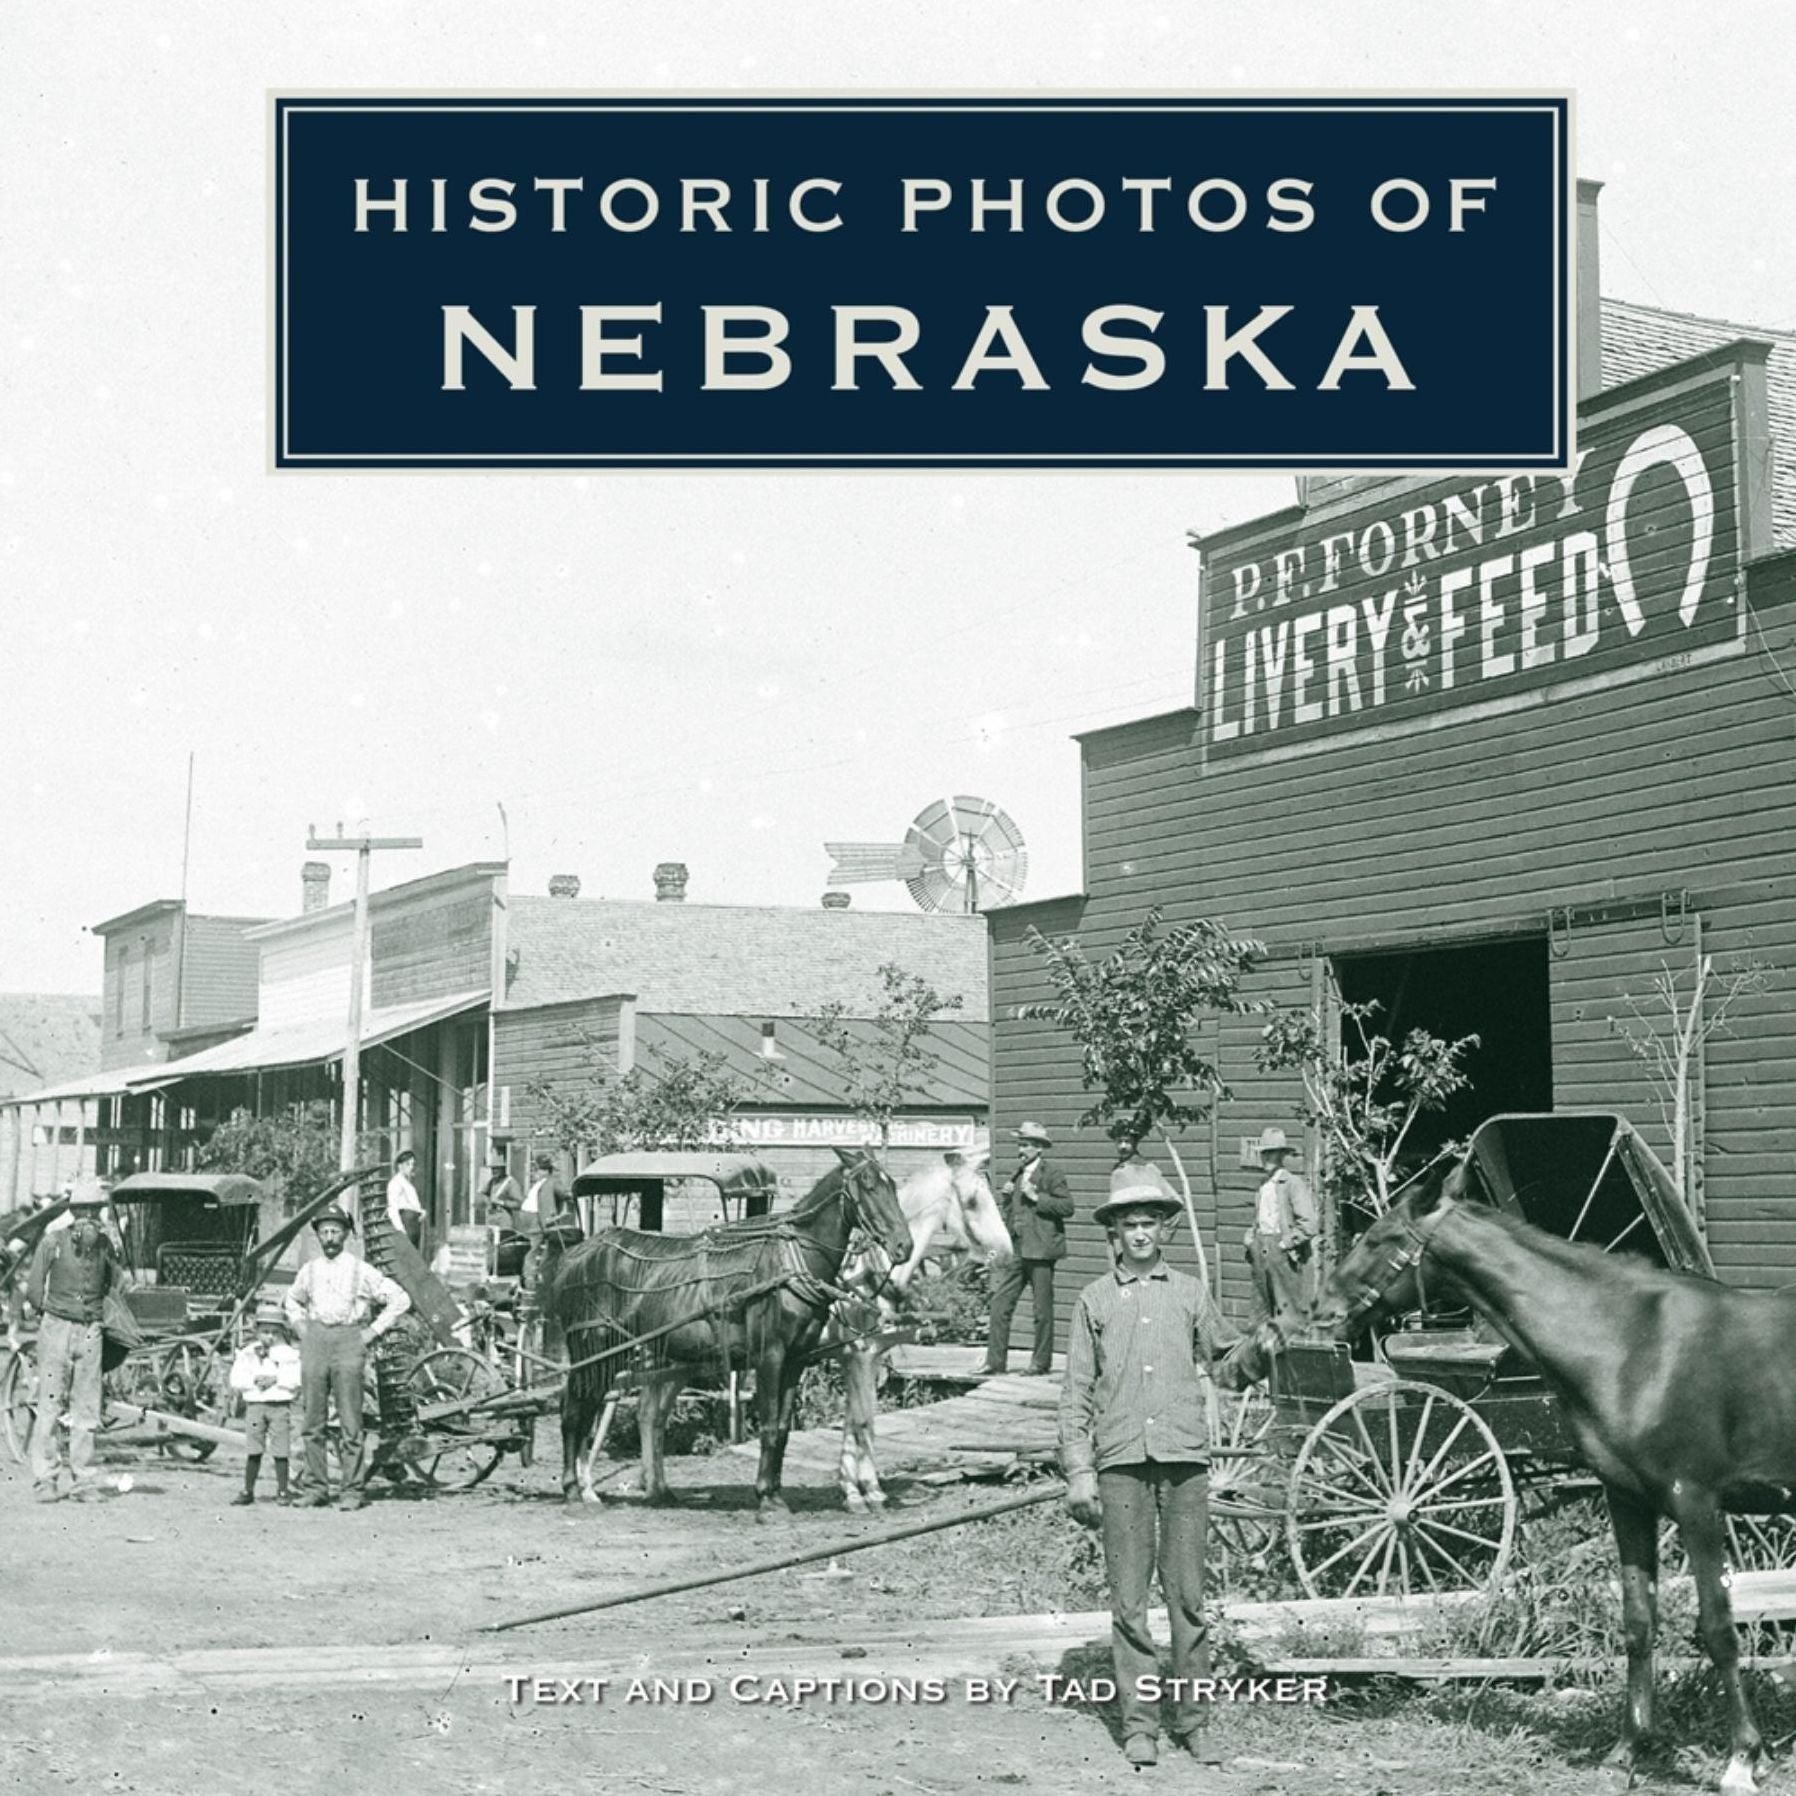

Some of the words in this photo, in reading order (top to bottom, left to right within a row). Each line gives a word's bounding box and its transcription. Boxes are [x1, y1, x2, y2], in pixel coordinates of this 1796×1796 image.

[1212, 588, 1403, 742] LIVERY
[1401, 605, 1431, 661] &
[1439, 530, 1600, 690] FEED
